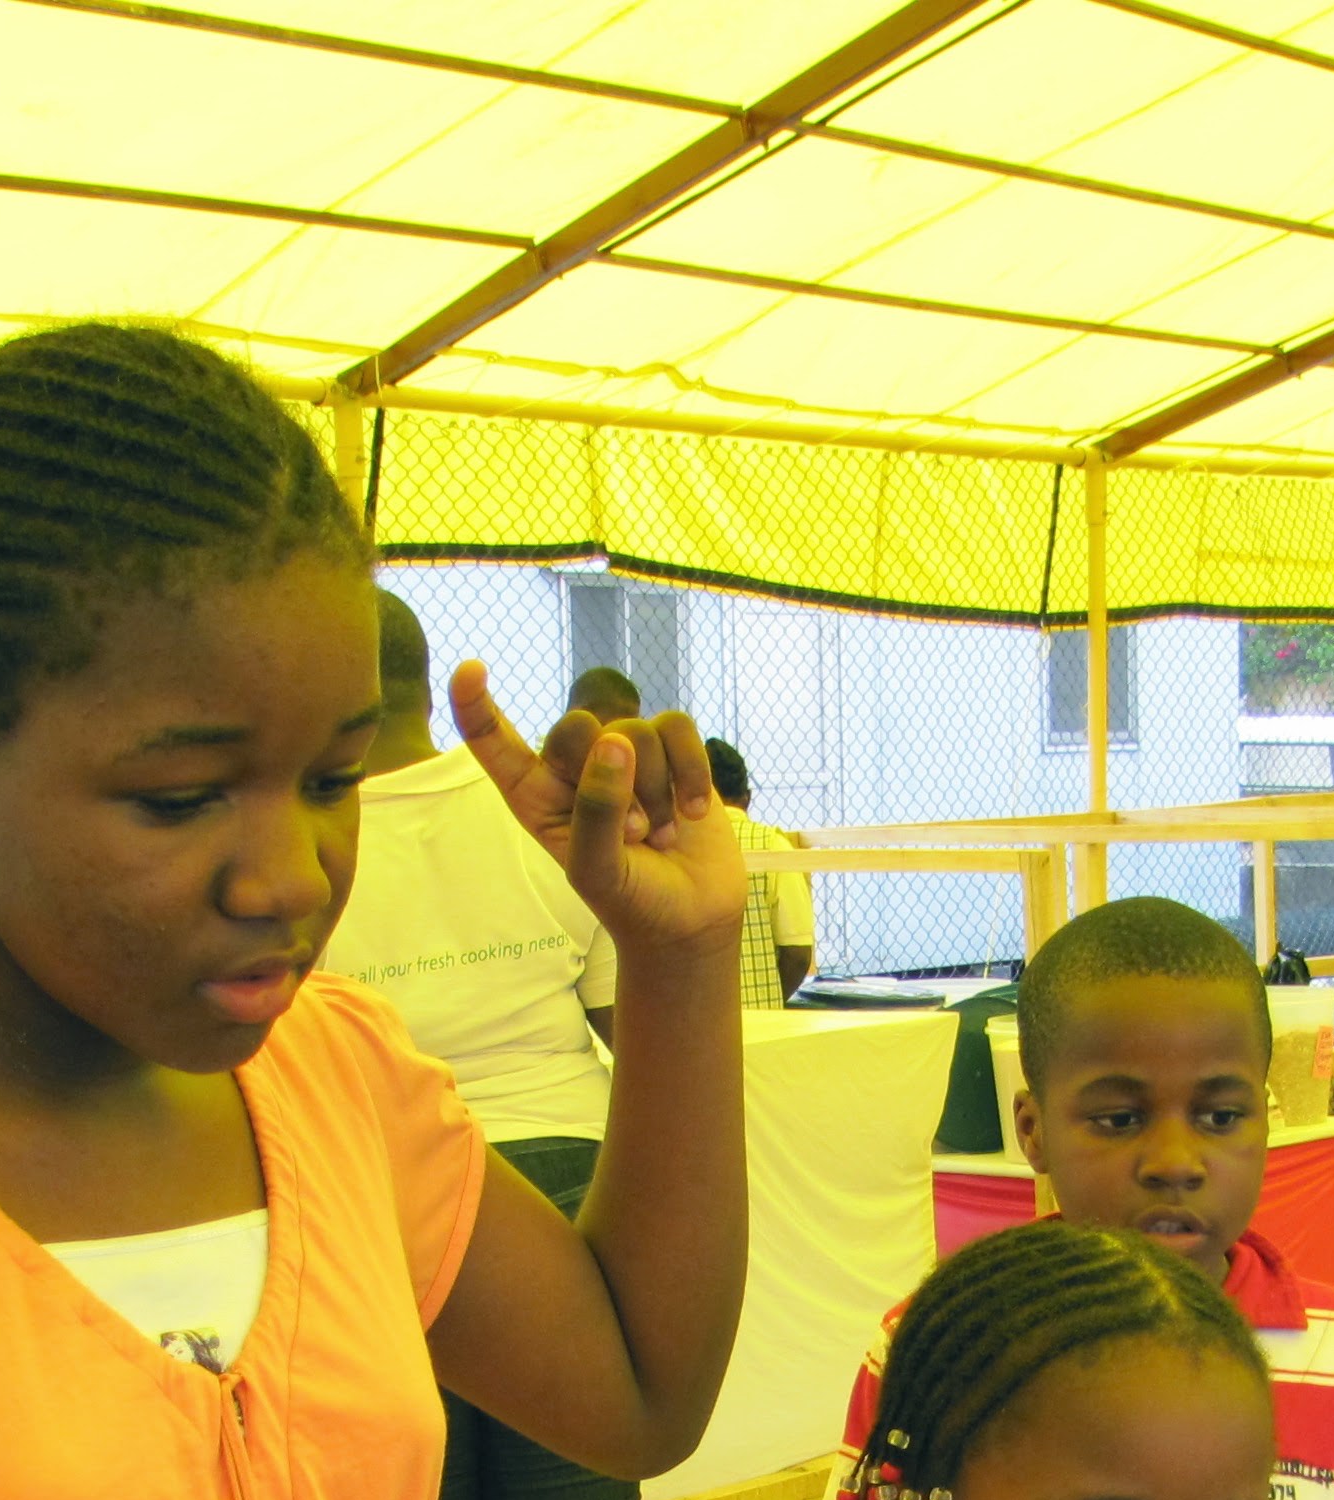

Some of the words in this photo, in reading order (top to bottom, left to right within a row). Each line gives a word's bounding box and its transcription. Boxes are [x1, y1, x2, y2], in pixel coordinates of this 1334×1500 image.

[358, 965, 377, 984] all
[380, 962, 412, 985] your
[417, 951, 455, 973] fresh
[460, 942, 524, 966] cooking
